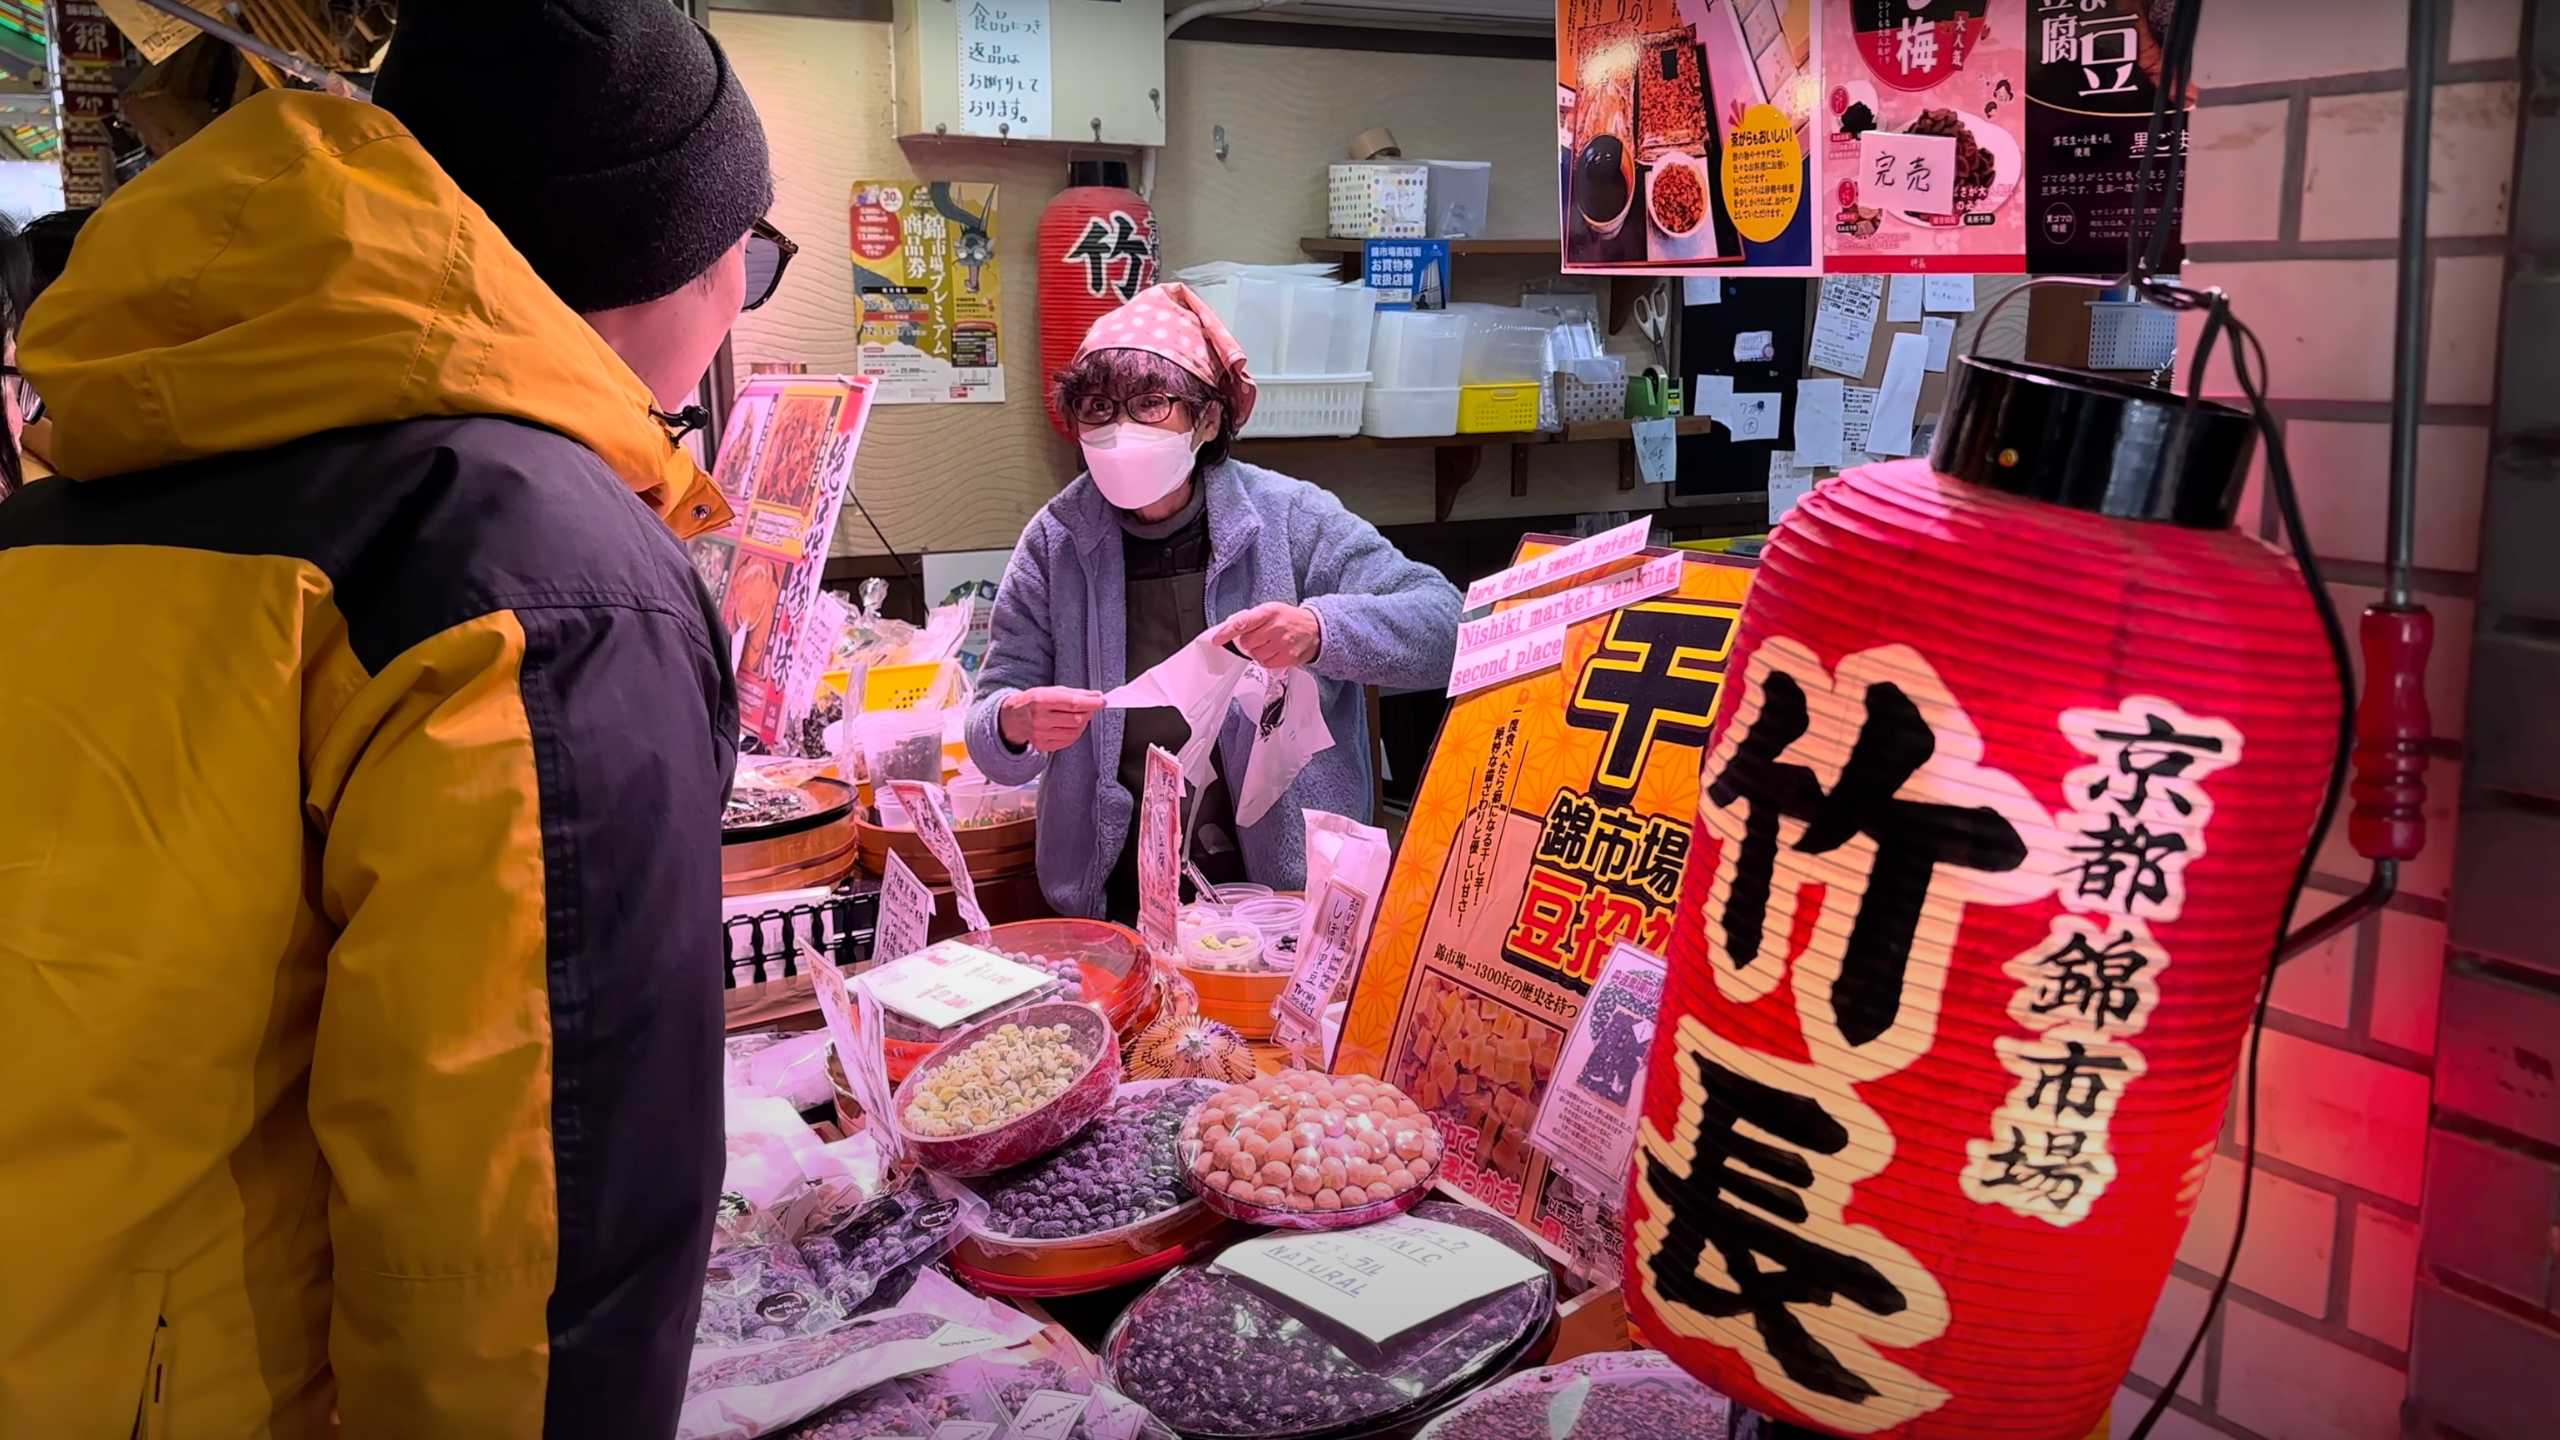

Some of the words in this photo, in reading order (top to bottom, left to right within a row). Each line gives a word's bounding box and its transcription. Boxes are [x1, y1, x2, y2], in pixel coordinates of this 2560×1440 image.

[968, 2, 1041, 34] 食品につき
[1952, 15, 1965, 67] 大人気
[968, 41, 1022, 65] 返品は
[968, 72, 1040, 94] お断りして
[968, 97, 1028, 124] おります。
[1874, 151, 1932, 192] 完売
[902, 213, 927, 280] 商品券
[923, 213, 949, 356] 錦市場プレミアム
[1502, 561, 1541, 593] dried
[1545, 547, 1587, 575] sweet
[1592, 527, 1645, 558] potato
[1460, 610, 1524, 651] Nishiki
[1529, 590, 1594, 626] market
[1600, 559, 1680, 601] ranking
[1452, 649, 1511, 688] second
[1514, 636, 1563, 672] place
[1538, 795, 1690, 898] 錦市場
[1980, 713, 2223, 1210] 京都錦市場
[1644, 669, 2028, 1404] 竹長
[1267, 1244, 1369, 1296] NATURAL
